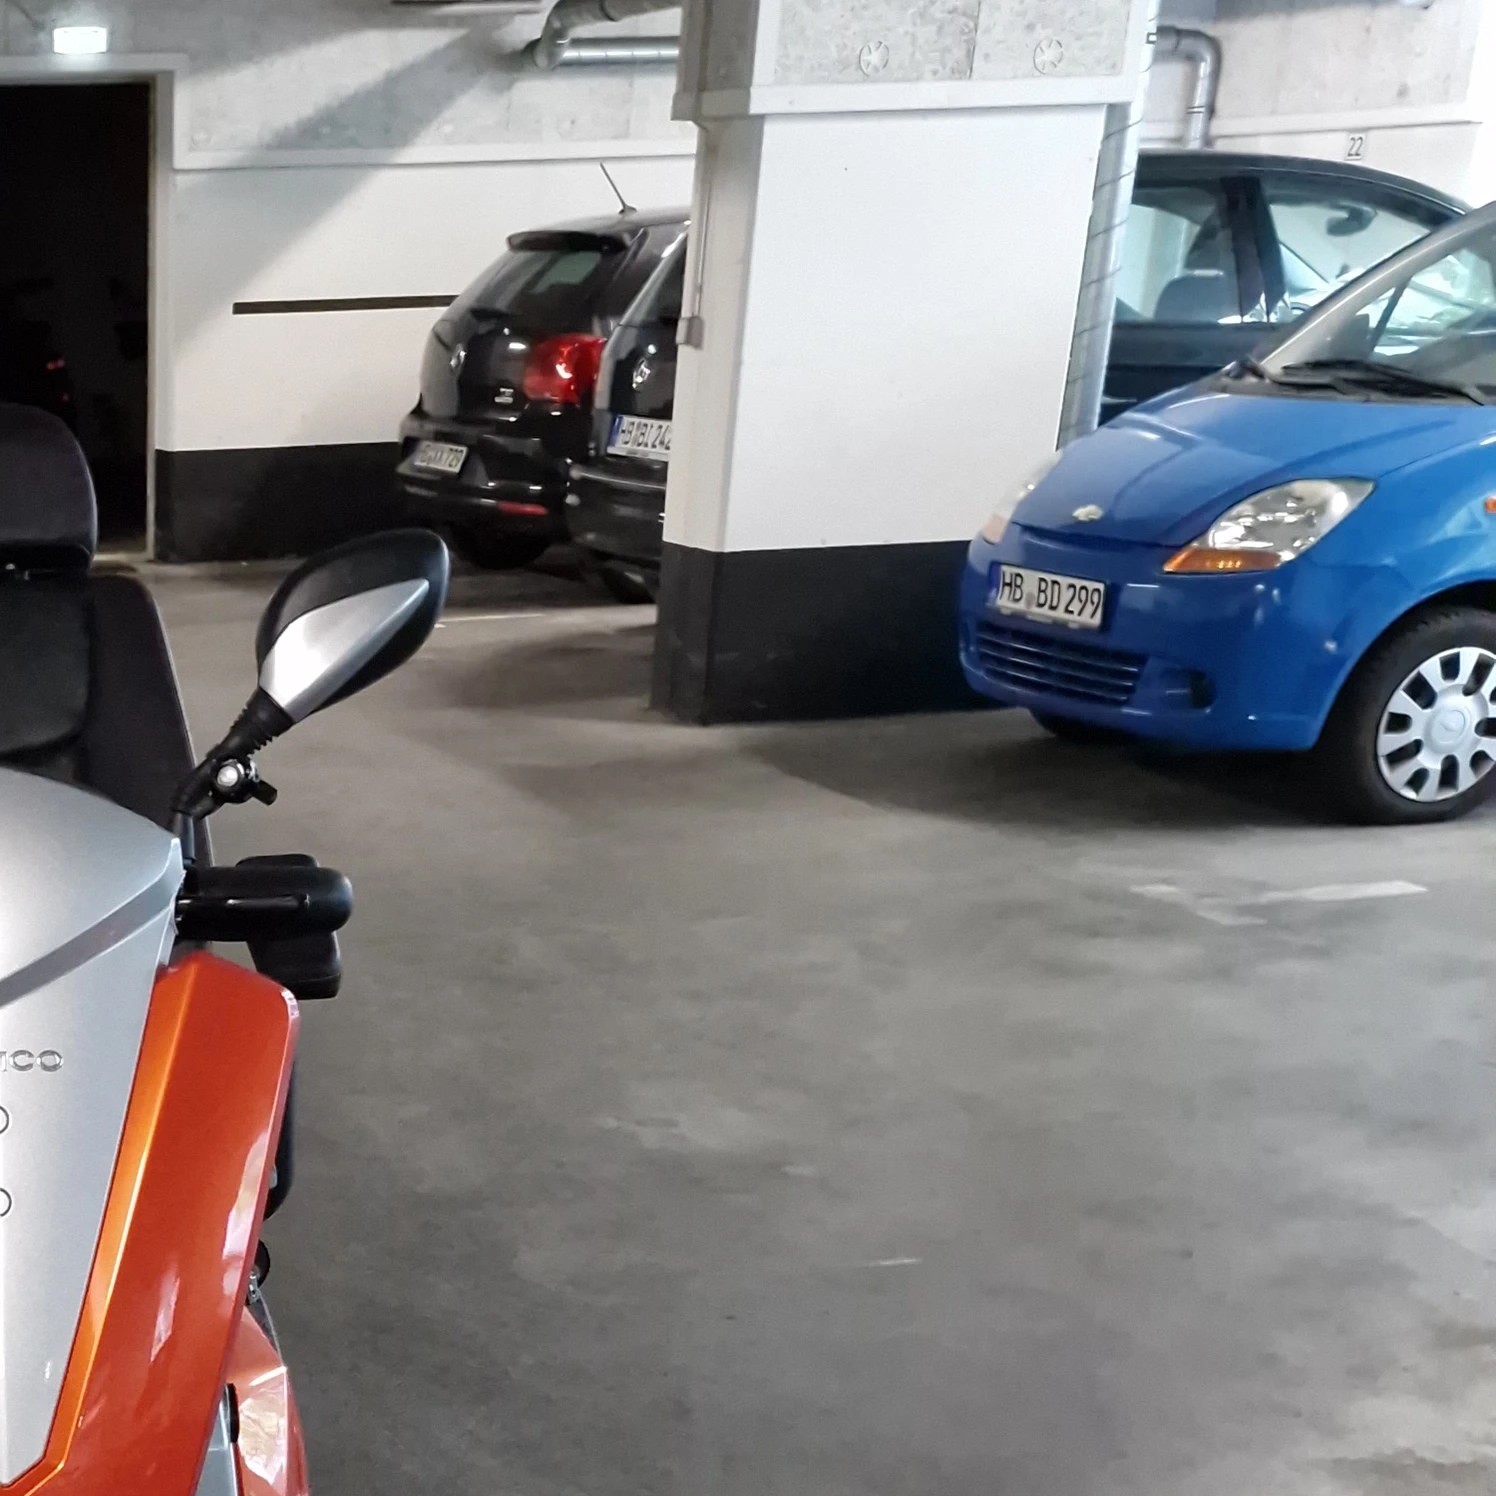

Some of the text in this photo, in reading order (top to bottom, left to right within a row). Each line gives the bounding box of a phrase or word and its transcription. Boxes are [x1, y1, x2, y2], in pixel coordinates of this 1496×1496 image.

[1347, 136, 1364, 157] 22
[1000, 571, 1102, 619] HB BD 299
